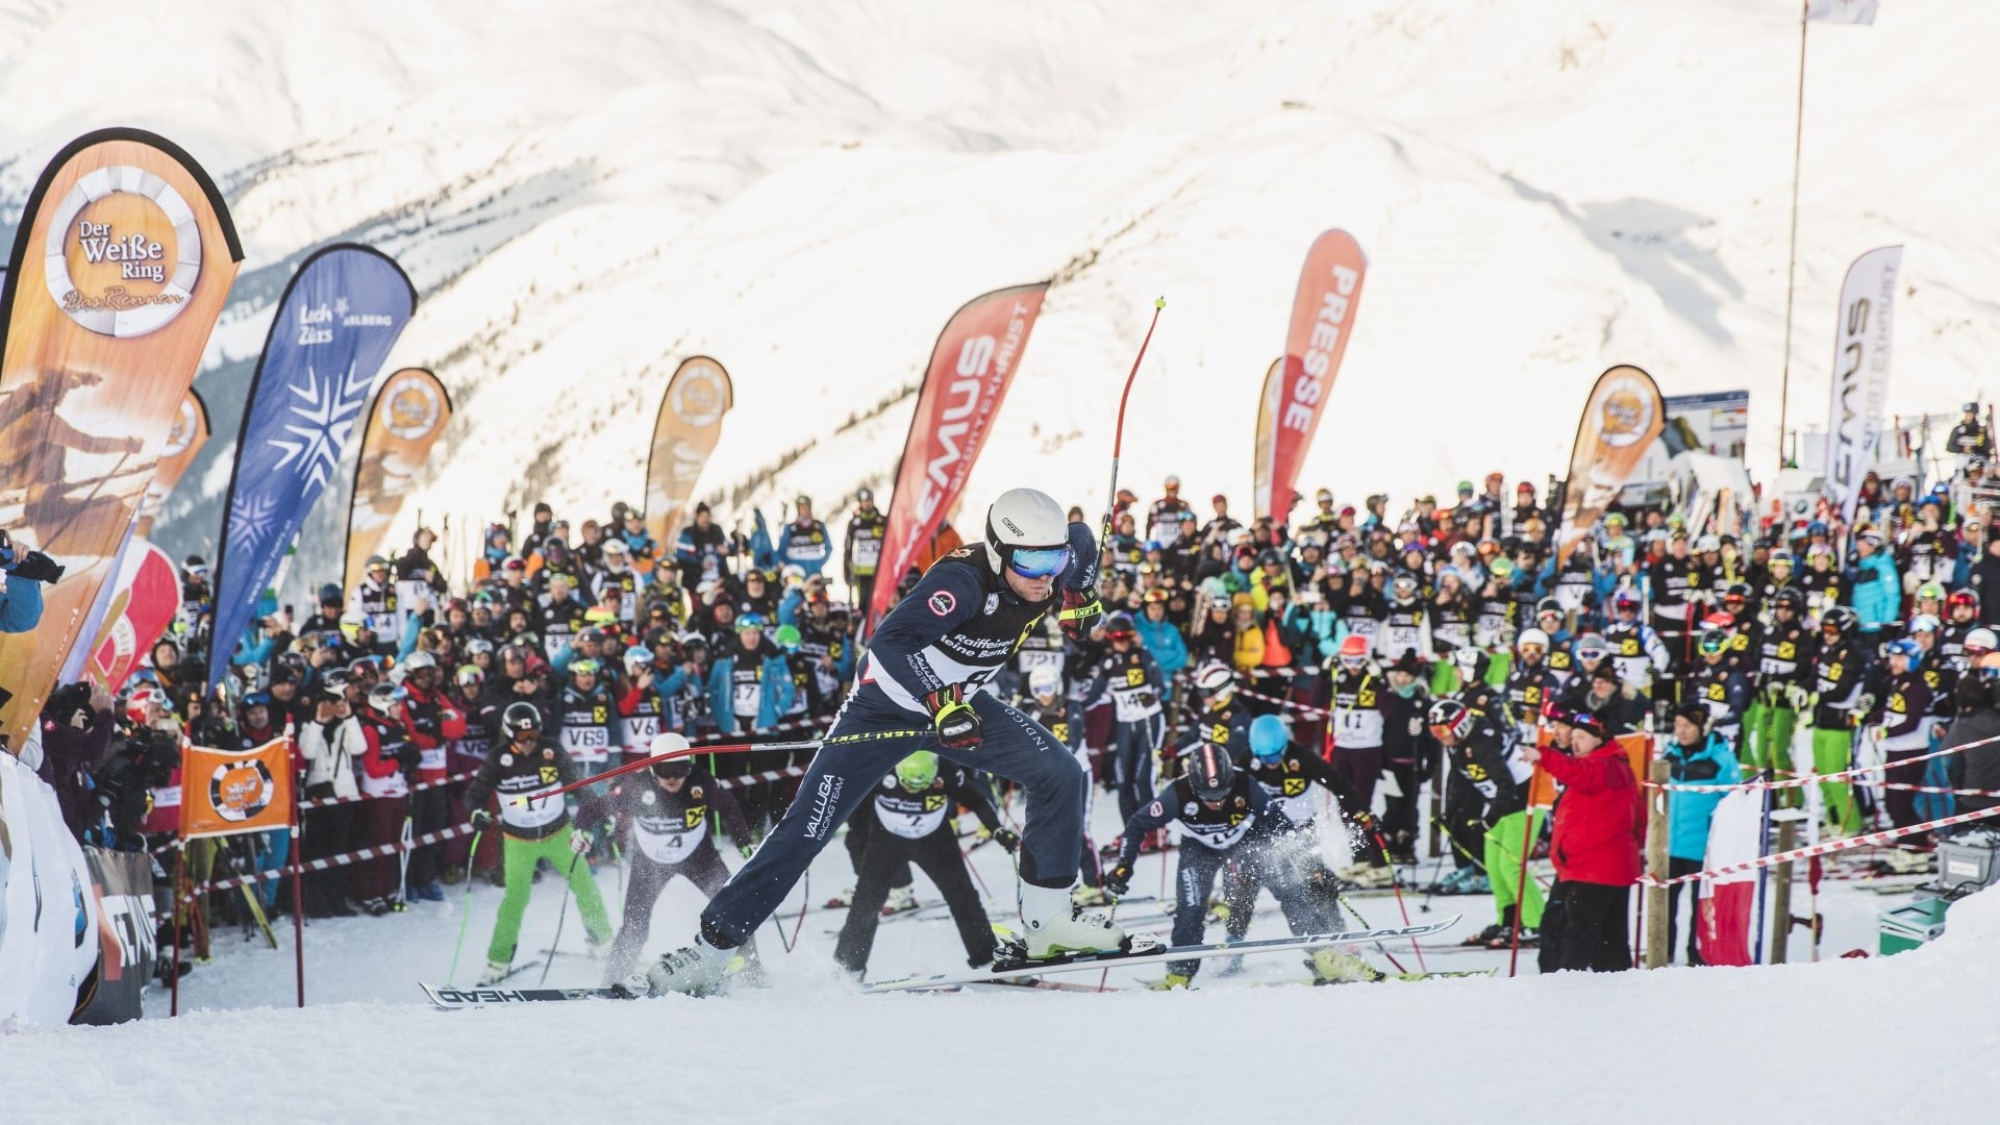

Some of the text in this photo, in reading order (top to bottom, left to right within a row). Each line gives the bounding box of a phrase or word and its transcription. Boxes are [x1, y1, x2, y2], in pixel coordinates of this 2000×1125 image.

[79, 221, 110, 238] Der
[79, 234, 164, 263] Weiße
[121, 261, 164, 283] Ring
[63, 285, 184, 311] Das Rennen
[299, 303, 392, 326] Lech ARLBERG
[1283, 264, 1358, 433] PRESSE
[1001, 517, 1025, 537] SCOTT
[953, 633, 1015, 650] Raiffeisen
[977, 646, 1009, 658] Bank
[1004, 708, 1049, 752] INDIGO
[803, 774, 835, 838] VALLUGA
[816, 776, 845, 841] RACING TEAM
[1310, 925, 1432, 943] HEAD
[437, 990, 528, 1003] HEAD
